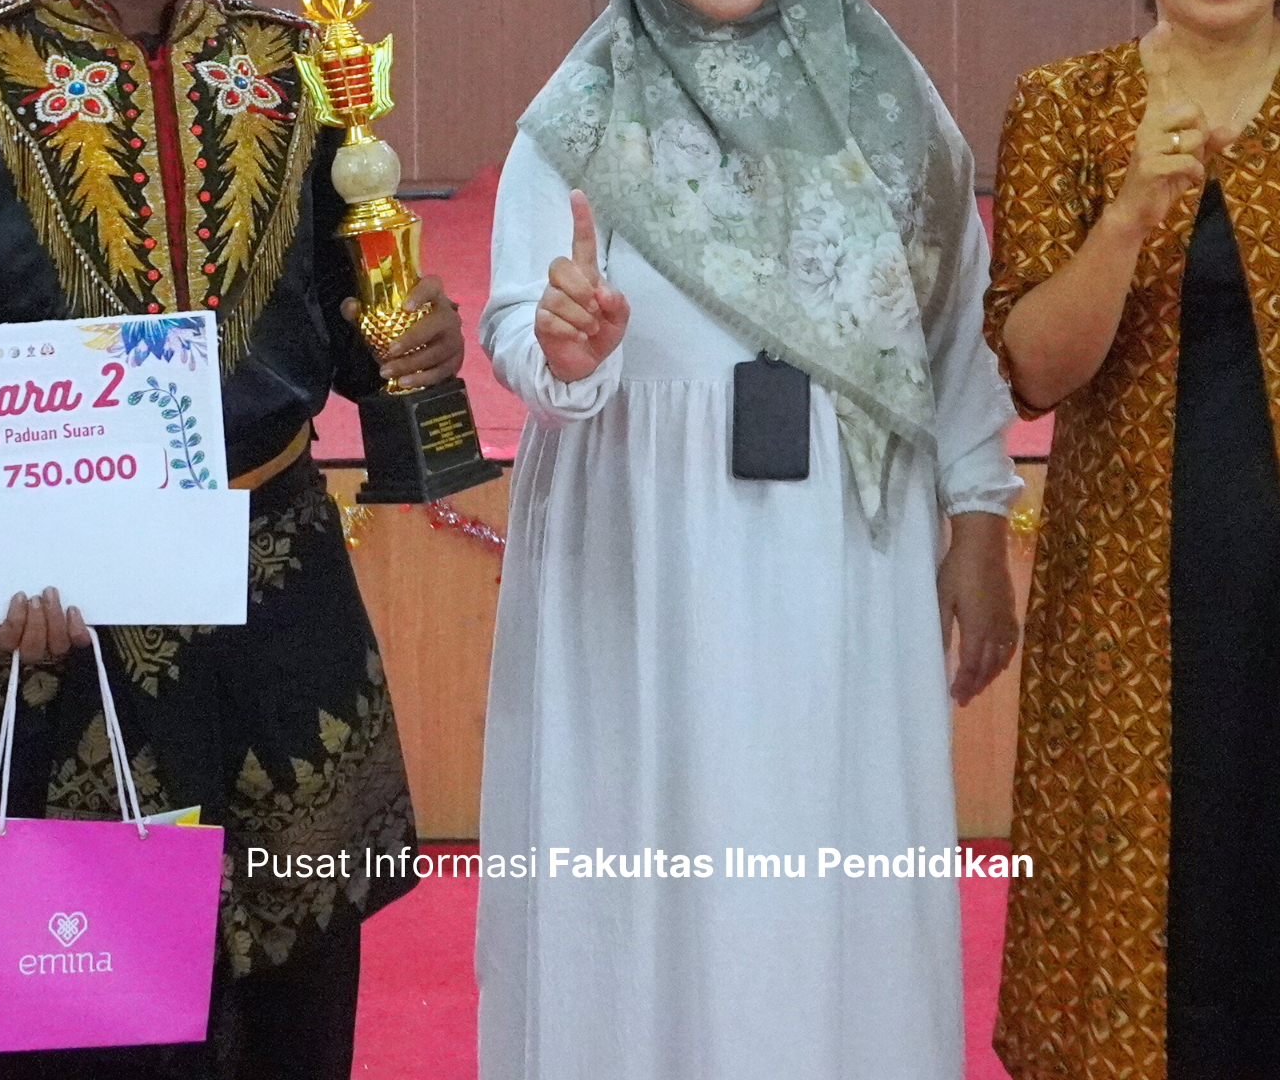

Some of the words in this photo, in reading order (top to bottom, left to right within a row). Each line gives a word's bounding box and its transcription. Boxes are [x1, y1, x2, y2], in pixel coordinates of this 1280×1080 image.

[92, 362, 125, 408] 2
[5, 428, 58, 444] Paduan
[63, 423, 105, 439] Suara
[3, 454, 137, 488] 750.000
[19, 950, 113, 975] emina
